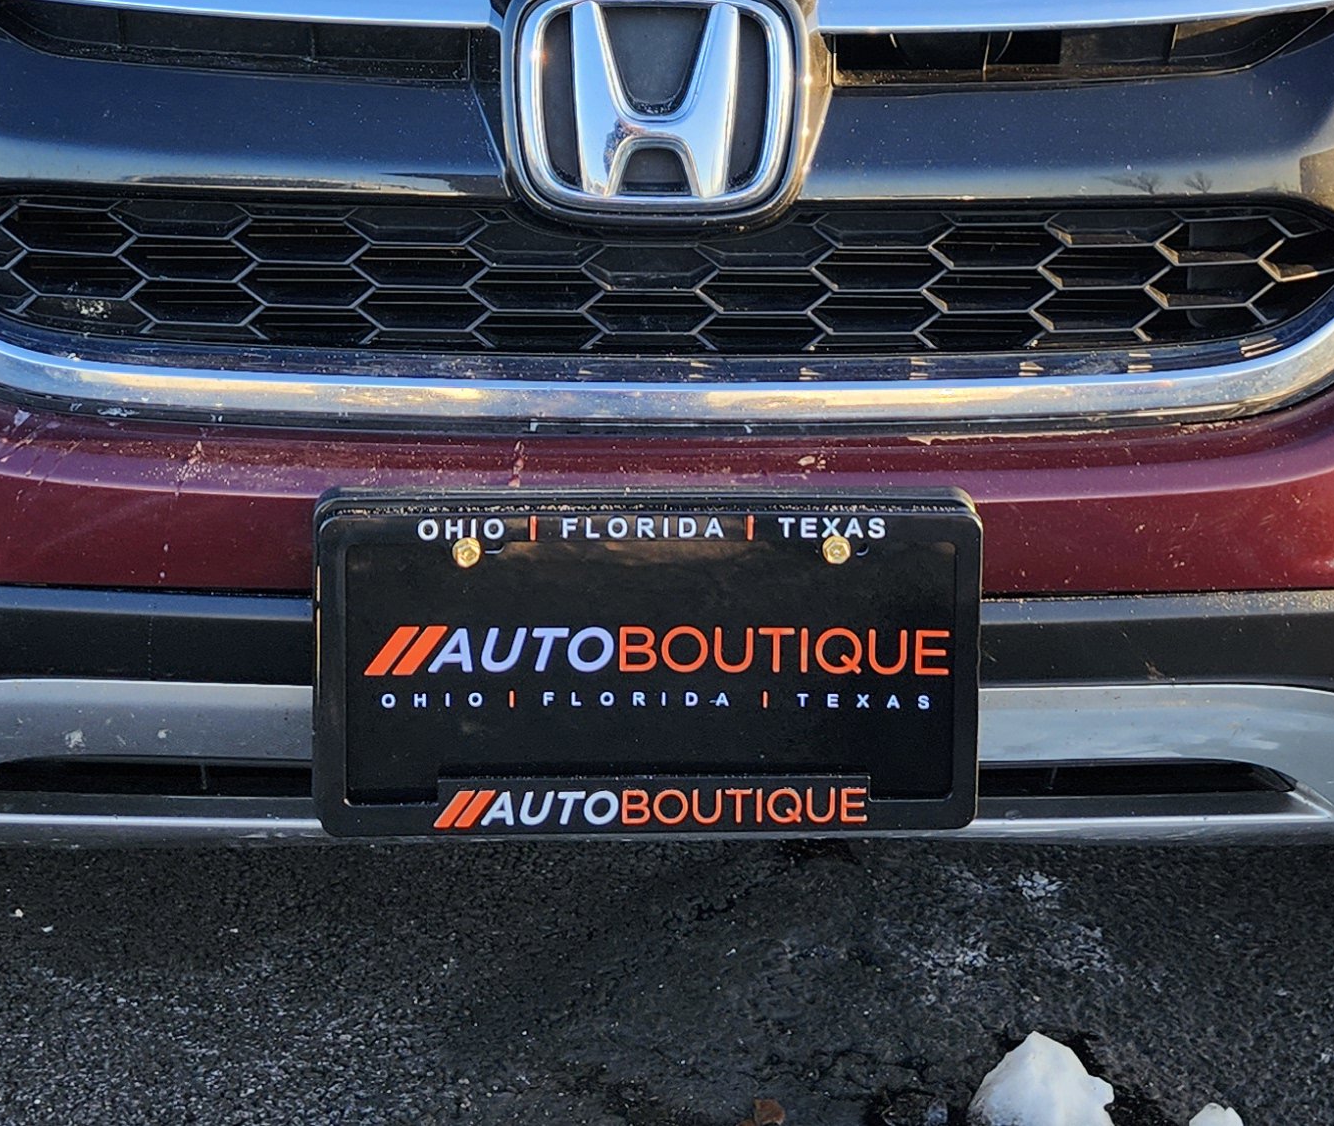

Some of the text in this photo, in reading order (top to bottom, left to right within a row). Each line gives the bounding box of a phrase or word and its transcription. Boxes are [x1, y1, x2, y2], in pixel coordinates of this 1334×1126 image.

[416, 516, 887, 542] OHIO FLORIDA TEXAS
[426, 625, 951, 676] AUTOBOUTIQUE
[380, 690, 931, 711] OHIO FLORIDA TEXAS
[479, 787, 868, 827] AUTOBOUTIQUE
